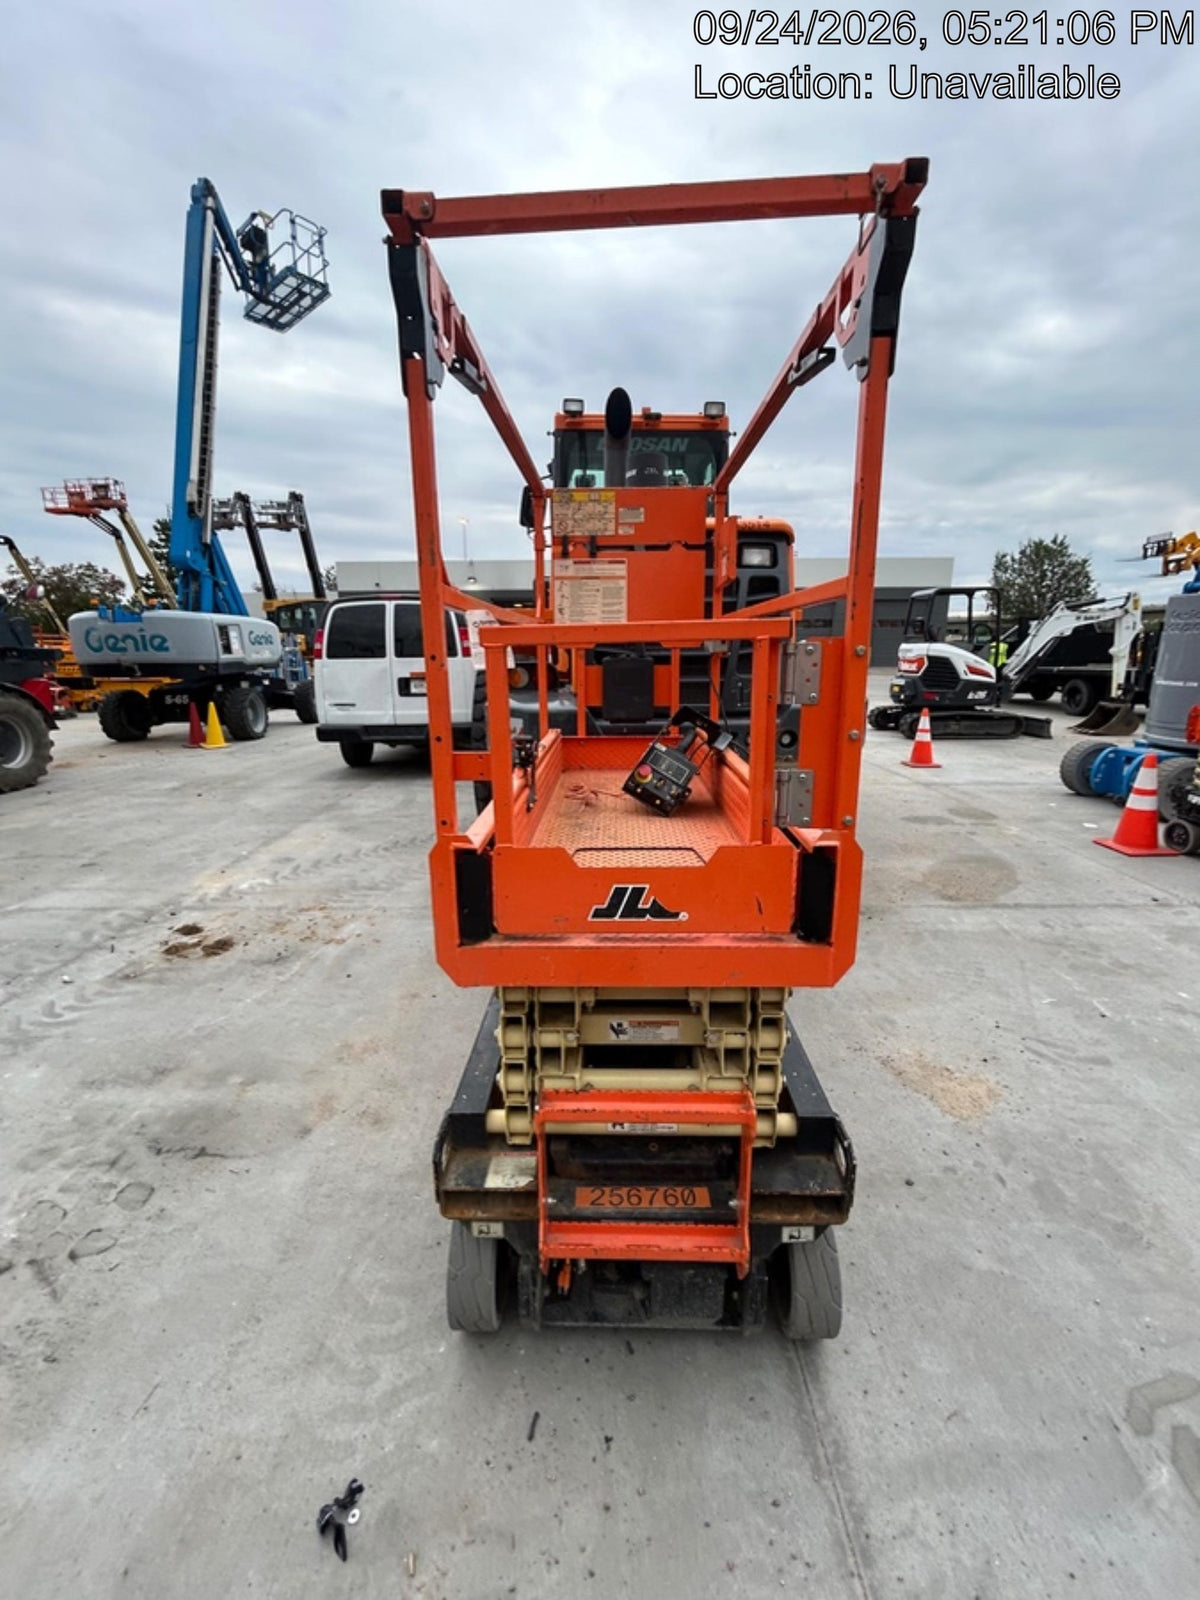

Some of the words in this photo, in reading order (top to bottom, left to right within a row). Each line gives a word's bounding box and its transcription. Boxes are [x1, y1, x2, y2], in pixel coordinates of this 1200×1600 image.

[597, 437, 690, 452] OSAN
[85, 627, 170, 653] Genie
[248, 630, 274, 646] Genie
[589, 1187, 697, 1207] 256760
